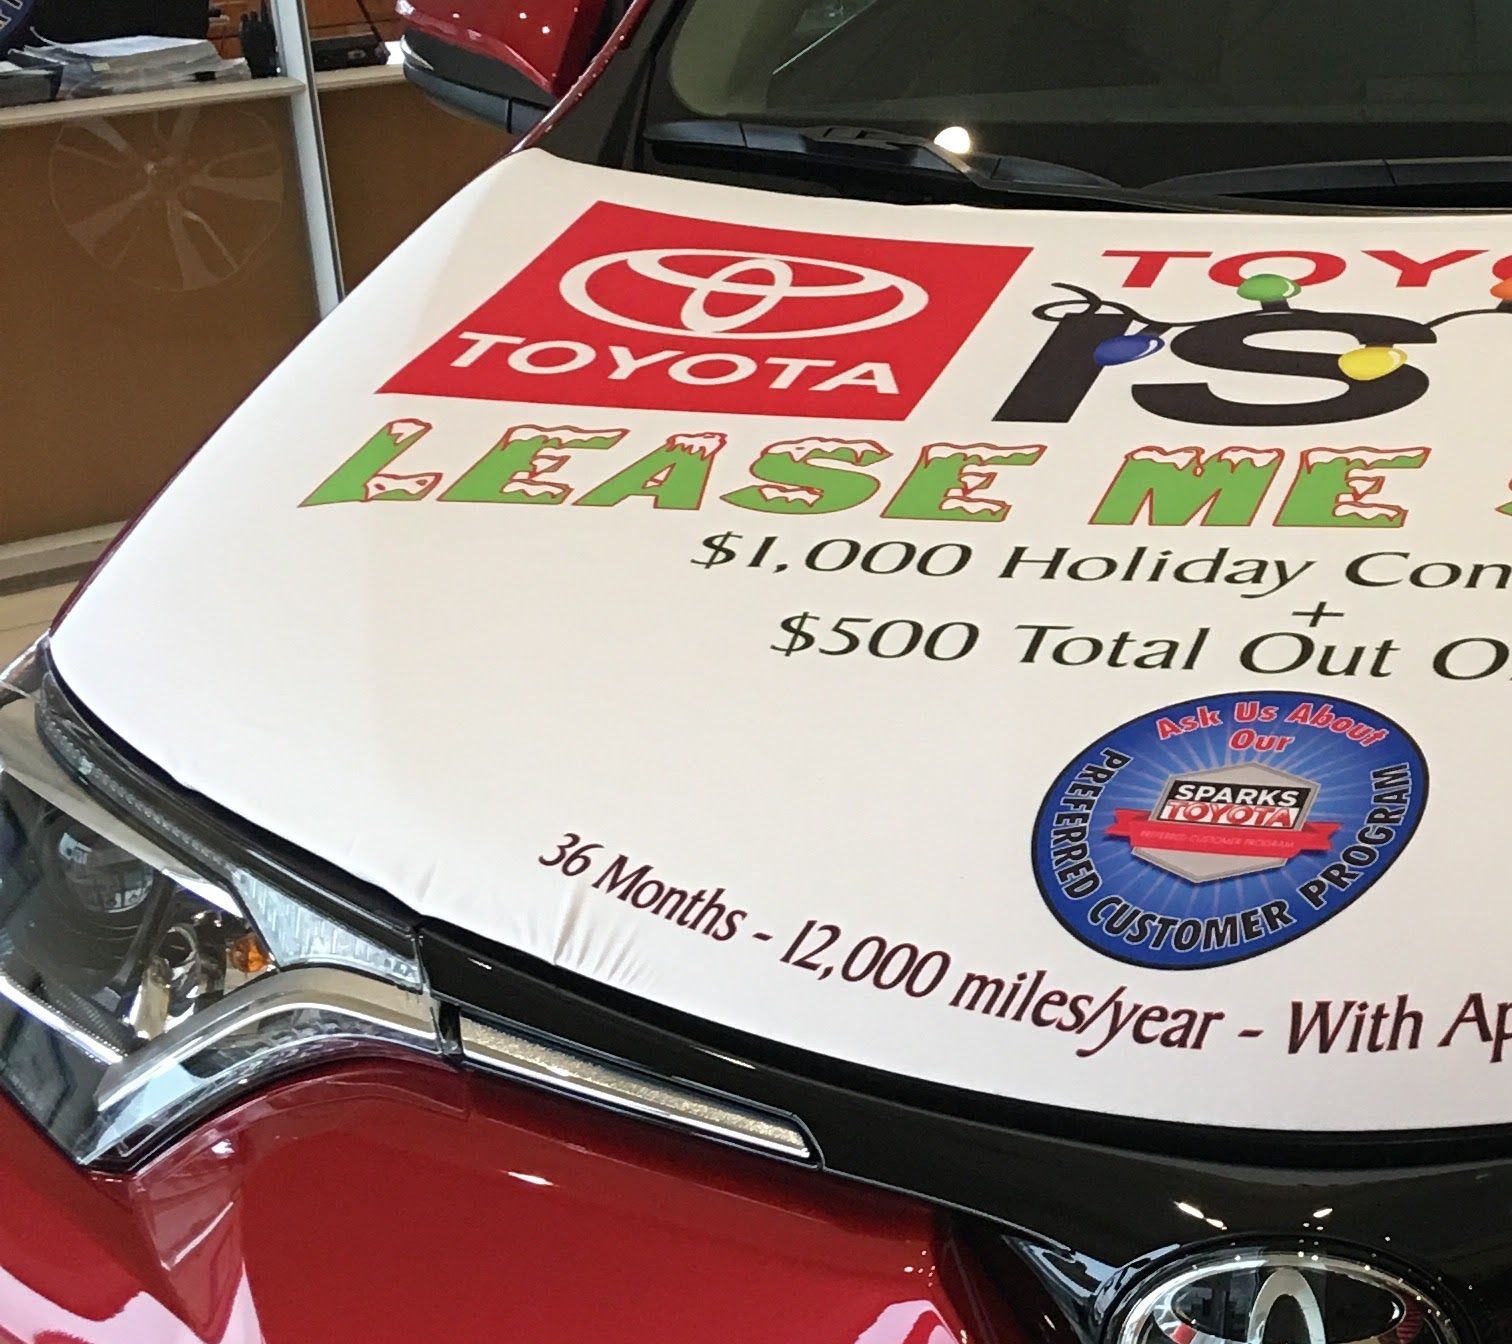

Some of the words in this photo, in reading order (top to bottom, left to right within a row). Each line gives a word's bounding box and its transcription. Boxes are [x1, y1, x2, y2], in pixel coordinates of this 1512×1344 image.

[449, 330, 901, 396] TOYOTA
[991, 309, 1438, 427] IS
[297, 418, 1048, 522] LEASE
[1087, 445, 1432, 528] ME
[690, 531, 974, 576] $1,000
[997, 545, 1317, 599] Holiday
[769, 611, 981, 660] $500
[1011, 624, 1212, 671] Total
[1238, 630, 1402, 679] Out
[1291, 600, 1345, 629] +
[1156, 706, 1223, 741] Ask
[1234, 700, 1279, 724] Us
[1286, 701, 1389, 747] About
[1228, 728, 1295, 752] Our
[1051, 747, 1132, 901] PREFERRED
[1166, 801, 1293, 828] TOYOTA
[1174, 783, 1300, 807] SPARKS
[1296, 761, 1410, 909] PROGRAM
[538, 832, 600, 878] 36
[592, 853, 748, 943] Months
[780, 918, 952, 998] 12,000
[948, 969, 1224, 1058] miles/year
[1286, 994, 1425, 1056] With
[1087, 895, 1297, 953] CUSTOMER
